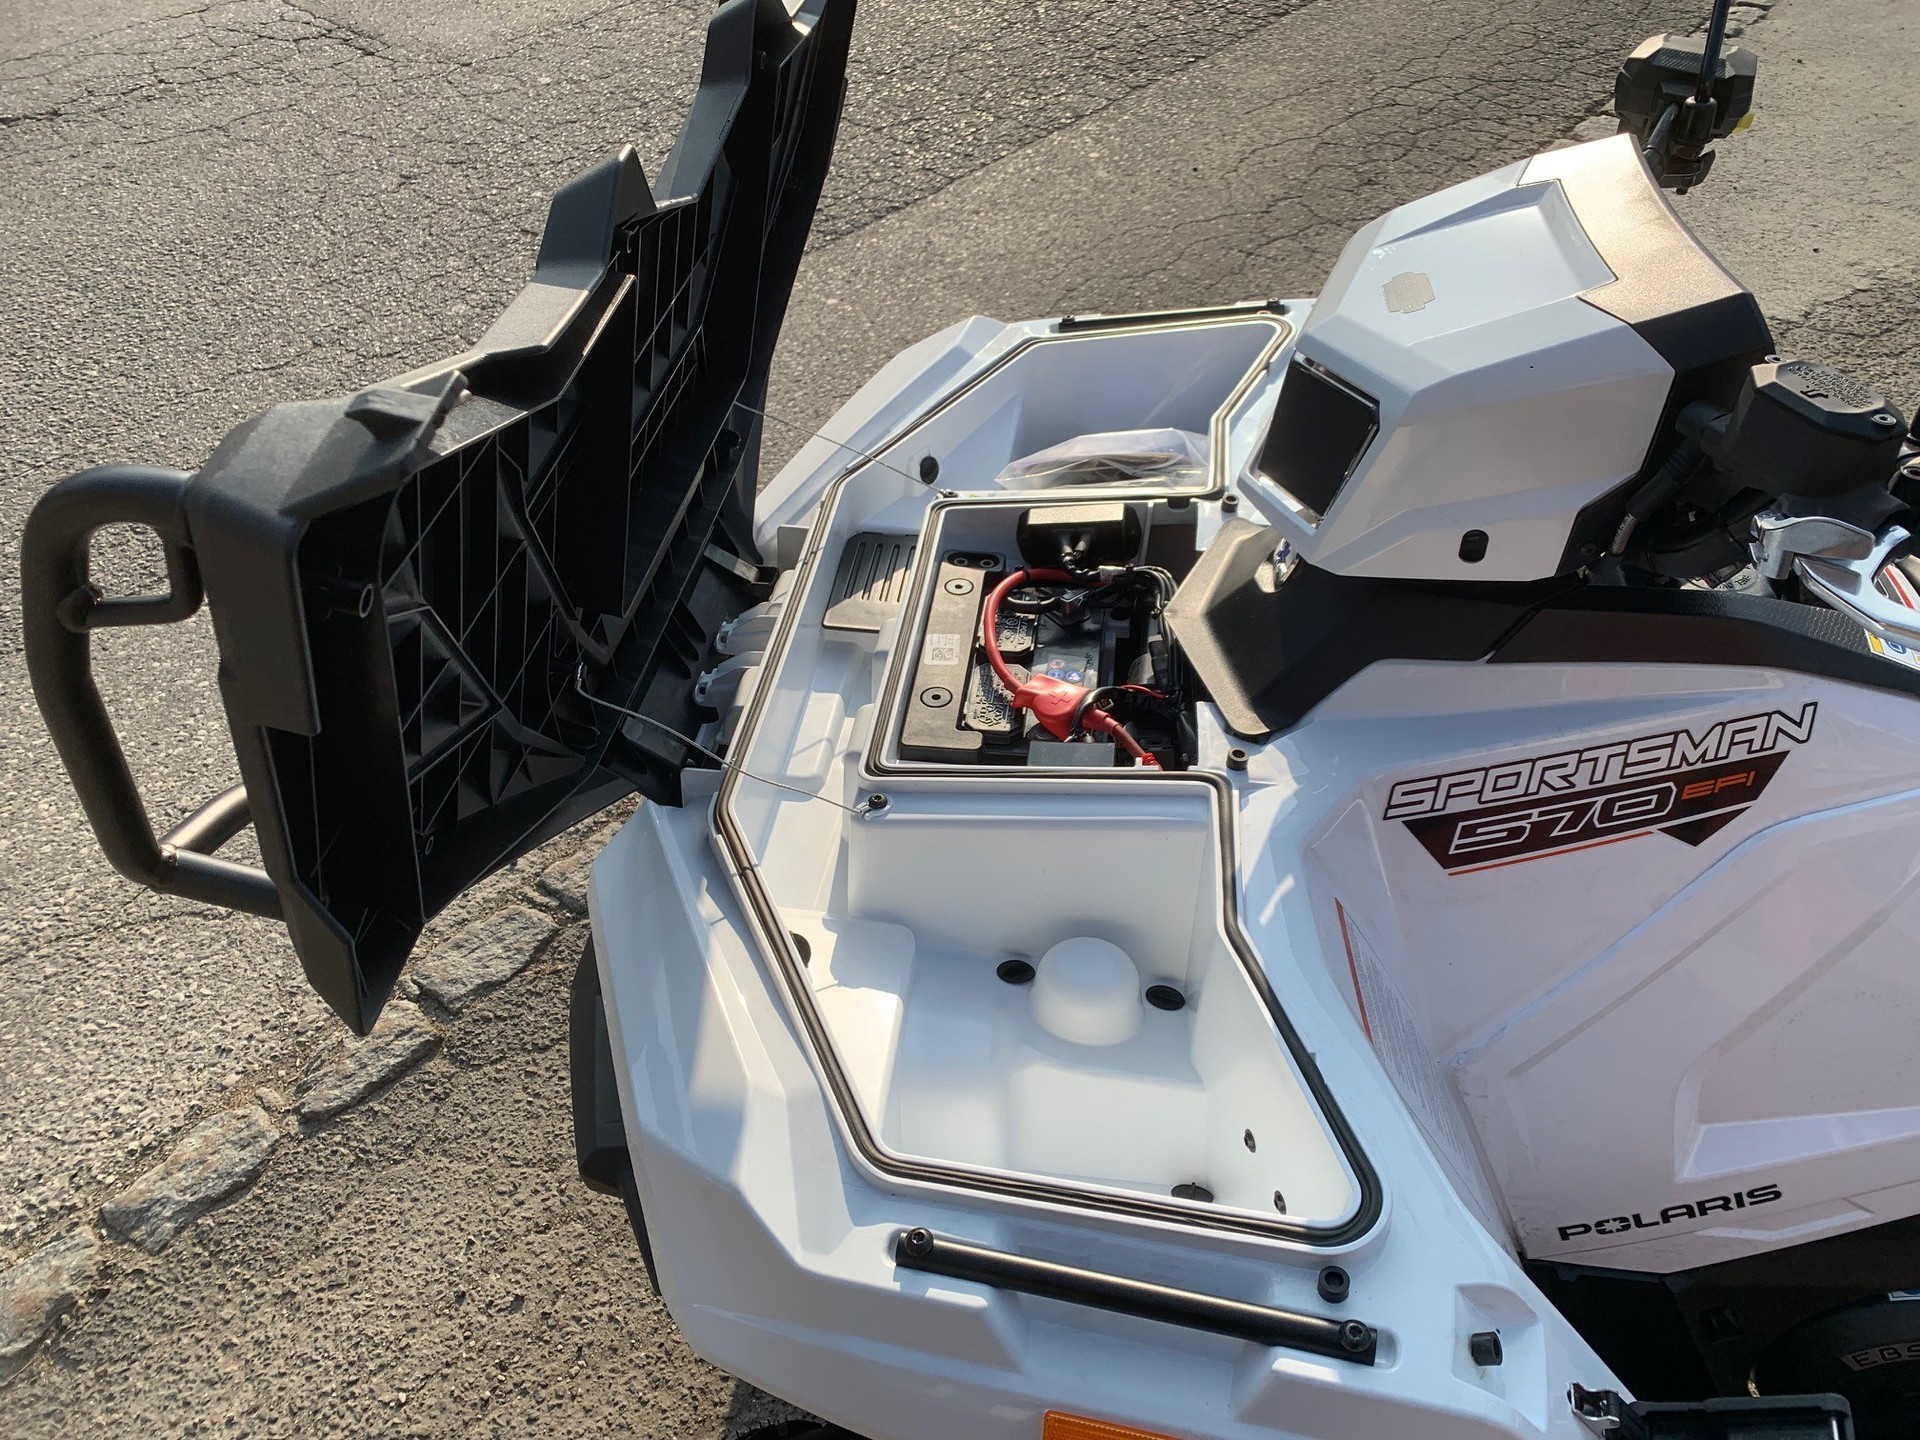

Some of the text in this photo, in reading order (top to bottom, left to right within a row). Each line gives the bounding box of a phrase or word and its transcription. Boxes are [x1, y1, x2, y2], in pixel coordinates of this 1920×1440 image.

[1384, 702, 1818, 820] SPORTSMAN
[1449, 771, 1756, 854] 570 EFI
[1557, 1184, 1783, 1241] POLARIS
